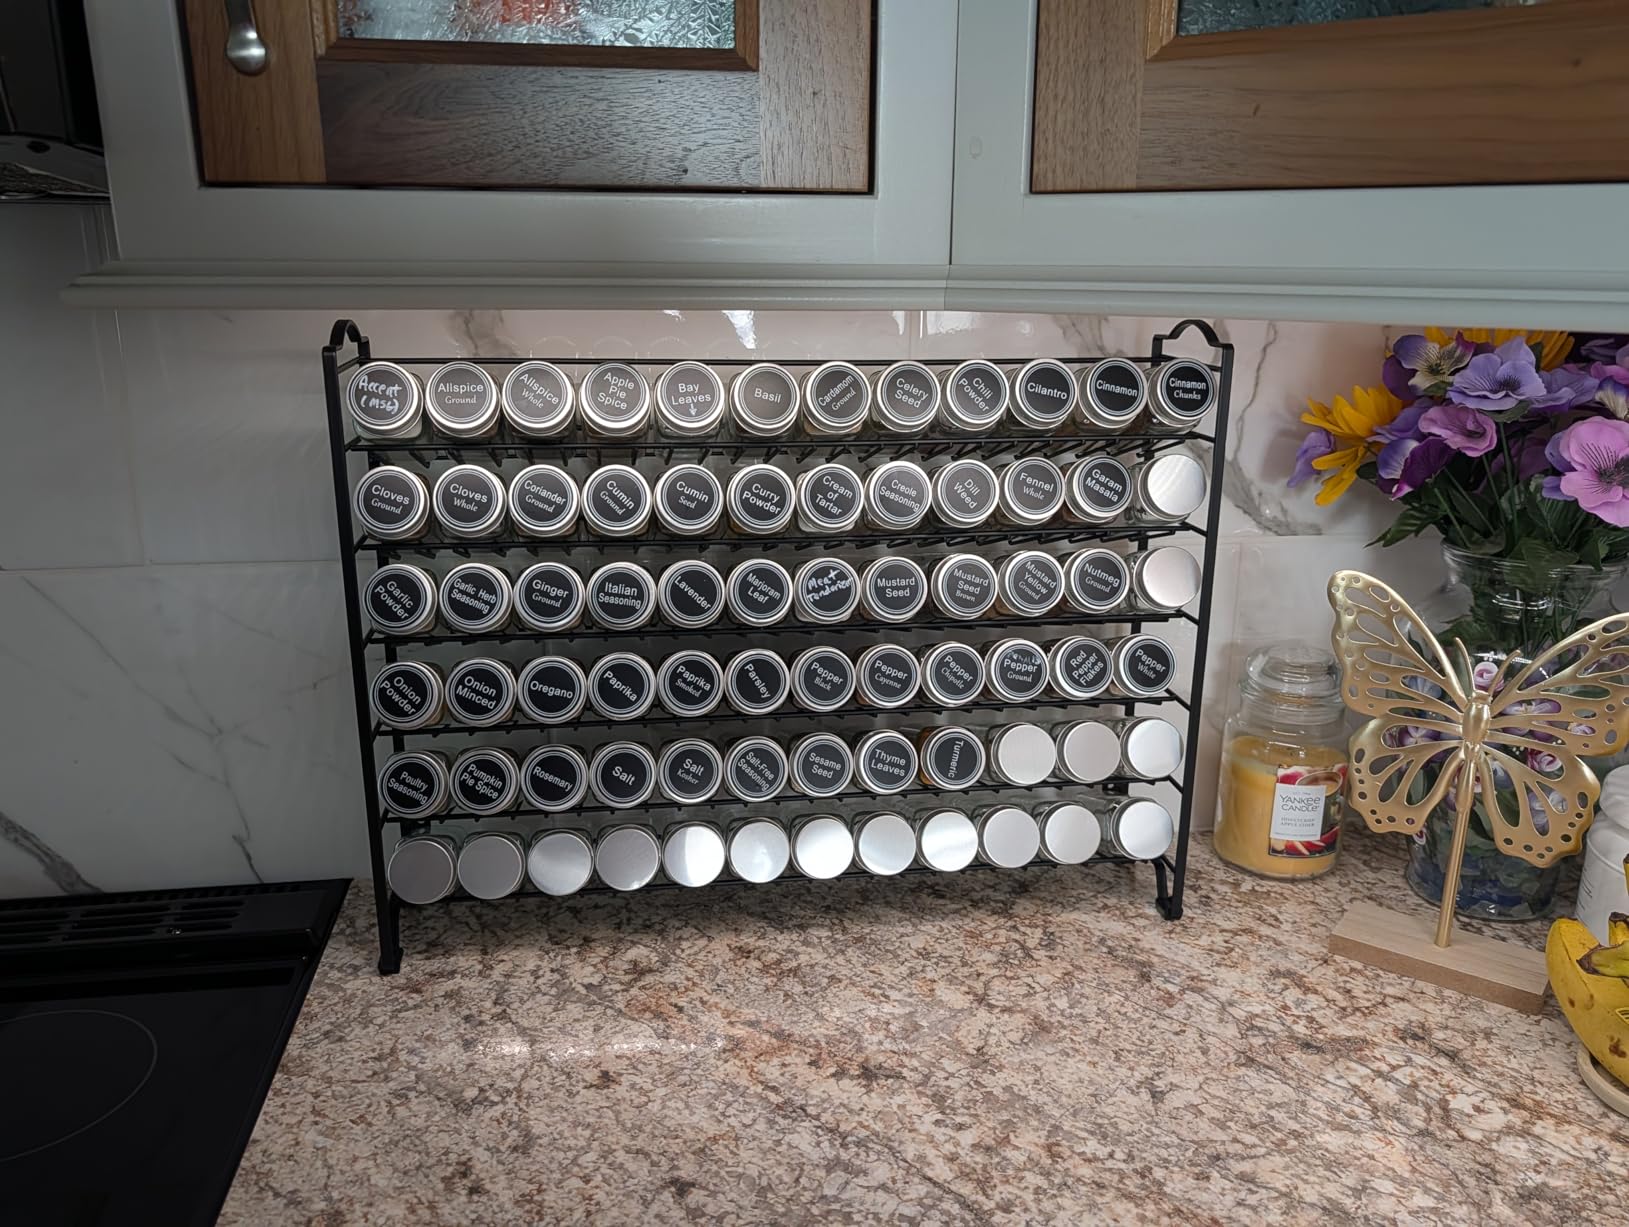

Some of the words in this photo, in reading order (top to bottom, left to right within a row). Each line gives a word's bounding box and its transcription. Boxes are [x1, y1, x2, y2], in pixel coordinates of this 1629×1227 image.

[358, 375, 402, 397] Accent
[438, 382, 484, 393] Allspice
[520, 373, 559, 405] Allspice
[604, 372, 635, 390] Apple
[678, 382, 699, 394] Bay
[818, 374, 855, 407] Cardamom
[896, 378, 929, 401] Celery
[972, 377, 993, 400] Chili
[1027, 382, 1068, 400] Cilantro
[1096, 380, 1138, 398] Cinnamon
[1169, 378, 1206, 390] Cinnamon
[445, 396, 476, 404] Ground
[522, 388, 544, 408] Whole
[598, 392, 627, 410] Spice
[608, 386, 627, 399] Pie
[672, 394, 711, 406] Leaves
[754, 388, 782, 403] Basil
[831, 387, 856, 411] Ground
[894, 389, 921, 408] Seed
[958, 377, 990, 412] Powder
[1174, 390, 1201, 400] Chunks
[822, 476, 853, 499] Cream
[891, 479, 918, 497] Creole
[964, 478, 981, 496] Dill
[1019, 472, 1054, 492] Fennel
[1085, 477, 1120, 502] Masala
[1091, 468, 1123, 492] Garam
[372, 484, 410, 505] Cloves
[450, 483, 488, 502] Cloves
[524, 480, 567, 505] Coriander
[606, 480, 635, 510] Cumin
[676, 481, 709, 503] Cumin
[752, 483, 780, 502] Curry
[827, 491, 840, 500] of
[879, 486, 920, 512] Seasoning
[954, 482, 978, 510] Weed
[1023, 485, 1045, 500] Whole
[371, 498, 402, 514] Ground
[453, 497, 478, 512] Whole
[525, 494, 555, 513] Ground
[600, 491, 626, 516] Ground
[679, 496, 696, 509] Seed
[742, 491, 782, 514] Powder
[815, 494, 842, 516] Tartar
[877, 577, 916, 587] Mustard
[953, 568, 989, 586] Mustard
[1024, 572, 1049, 595] Yellow
[1025, 561, 1057, 589] Mustard
[1084, 563, 1121, 588] Nutmeg
[1085, 576, 1112, 593] Ground
[386, 581, 414, 608] Garlic
[454, 578, 476, 595] Garlic
[478, 587, 497, 604] Herb
[532, 580, 569, 599] Ginger
[605, 582, 638, 596] Italian
[674, 576, 712, 610] Lavender
[746, 573, 782, 600] Marjoram
[748, 587, 769, 604] Leaf
[886, 588, 910, 597] Seed
[955, 590, 976, 602] Brown
[958, 580, 981, 594] Seed
[1018, 581, 1042, 600] Ground
[374, 585, 409, 620] Powder
[451, 589, 490, 614] Seasoning
[532, 592, 562, 608] Ground
[598, 593, 642, 610] Seasoning
[944, 655, 974, 682] Pepper
[1004, 658, 1038, 673] Pepper
[1070, 650, 1088, 668] Red
[1072, 653, 1099, 680] Pepper
[1135, 649, 1166, 673] Pepper
[676, 665, 712, 691] Paprika
[811, 662, 844, 686] Pepper
[874, 660, 909, 680] Pepper
[941, 667, 966, 690] Chipotle
[1007, 671, 1033, 683] Ground
[1079, 661, 1105, 686] Flakes
[1137, 662, 1157, 680] White
[393, 676, 421, 704] Onion
[464, 676, 497, 697] Onion
[529, 680, 574, 699] Oregano
[604, 671, 638, 701] Paprika
[675, 678, 703, 698] Smoked
[744, 664, 771, 699] Parsley
[814, 676, 832, 692] Black
[874, 672, 902, 689] Cayenne
[380, 681, 416, 715] Powder
[456, 685, 496, 709] Minced
[683, 758, 704, 776] Salt
[746, 752, 774, 780] Salt-Free
[808, 752, 842, 771] Sesame
[875, 749, 906, 766] Thyme
[948, 740, 964, 778] Turmeric
[468, 763, 503, 789] Pumpkin
[612, 766, 636, 785] Salt
[676, 768, 700, 785] Kosher
[738, 758, 770, 792] Seasoning
[812, 764, 834, 779] Seed
[871, 759, 906, 777] Leaves
[400, 772, 429, 792] Poultry
[460, 774, 475, 787] Pie
[475, 782, 499, 799] Spice
[532, 766, 573, 792] Rosemary
[388, 778, 428, 805] Seasoning
[1280, 795, 1320, 806] YANKEE
[1281, 803, 1318, 812] CANDLE
